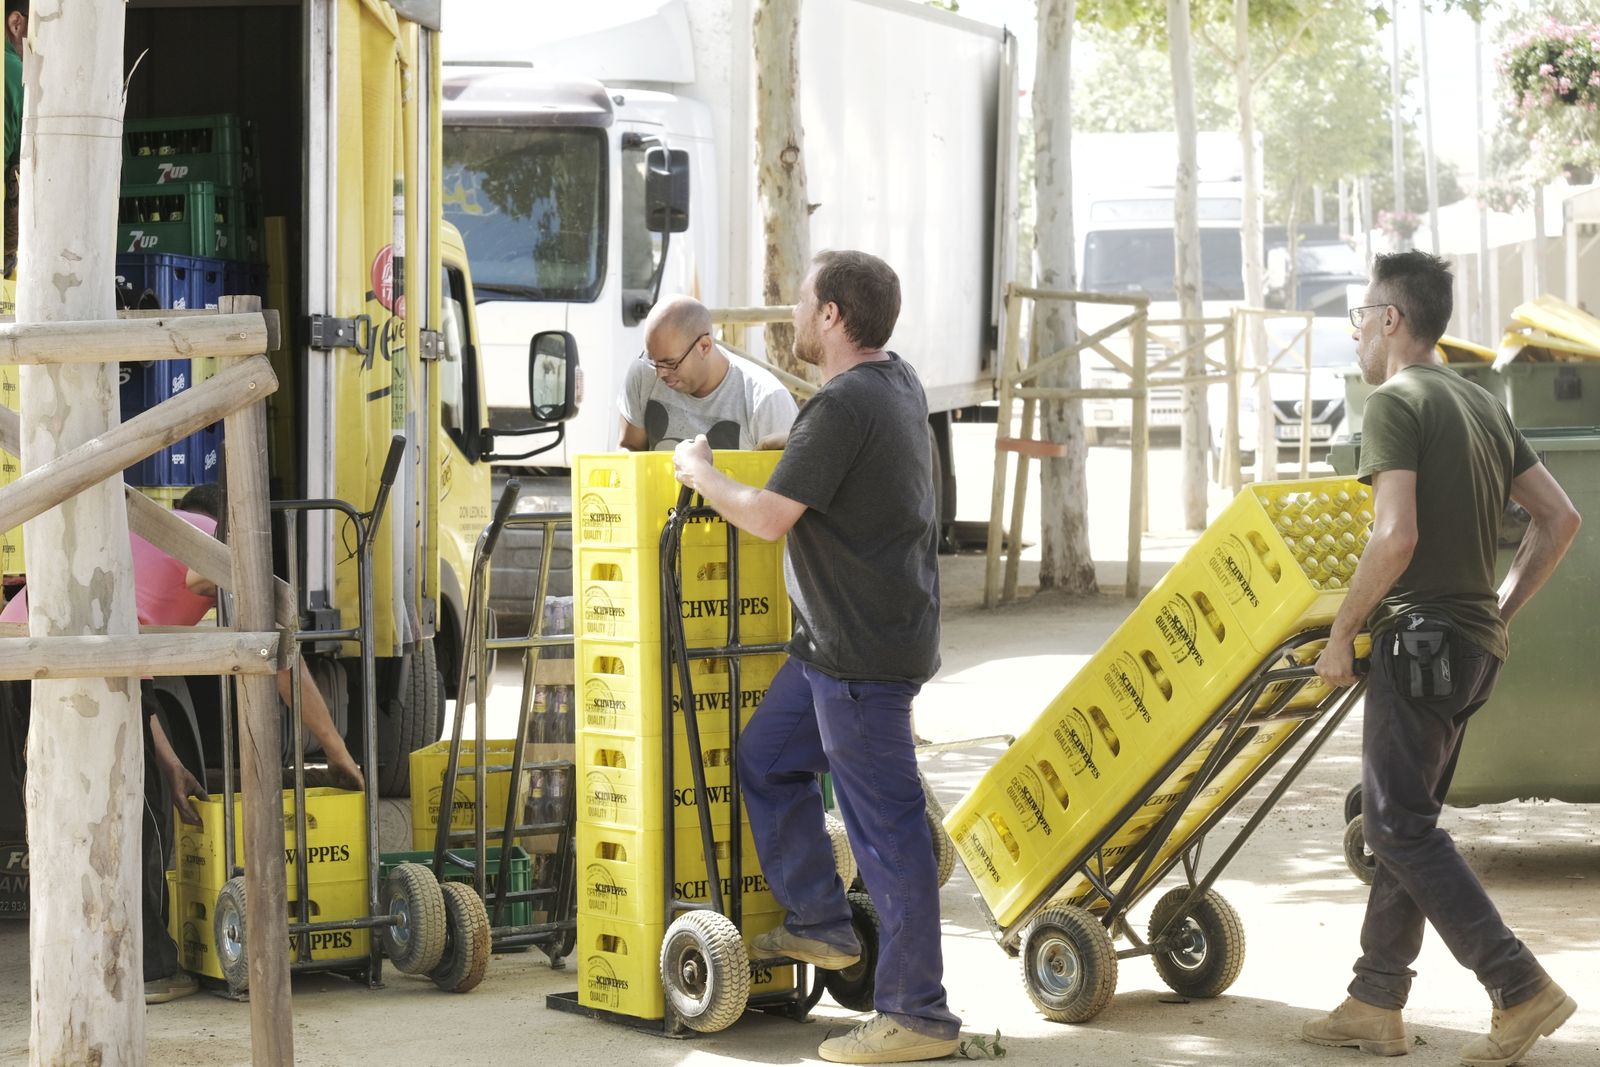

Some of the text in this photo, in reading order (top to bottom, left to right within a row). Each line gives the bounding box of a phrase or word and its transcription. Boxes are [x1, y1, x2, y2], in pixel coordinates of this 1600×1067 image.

[157, 163, 188, 184] 7UP
[127, 230, 158, 252] 7UP
[590, 513, 621, 523] SCHWEPPES
[1209, 557, 1231, 587] QUALITY
[1226, 556, 1260, 608] SCHWEPPES
[593, 606, 625, 617] SCHWEPPES
[680, 596, 769, 618] CHWEPES
[1155, 615, 1176, 647] QUALITY
[1172, 615, 1205, 667] SCHWEPPES
[1104, 672, 1124, 703] QUALITY
[1120, 672, 1152, 723] SCHWEPPES
[594, 698, 626, 711] SCHWEPPES
[1054, 729, 1074, 759] QUALITY
[1069, 728, 1101, 780] SCHWEPPES
[595, 791, 627, 804] SCHWEPPES
[1006, 786, 1025, 815] QUALITY
[1021, 786, 1053, 836] SCHWEPPES
[971, 833, 1001, 883] SCHWEPPES
[595, 882, 628, 897] SCHWEPPES
[596, 976, 629, 990] SCHWEPPES
